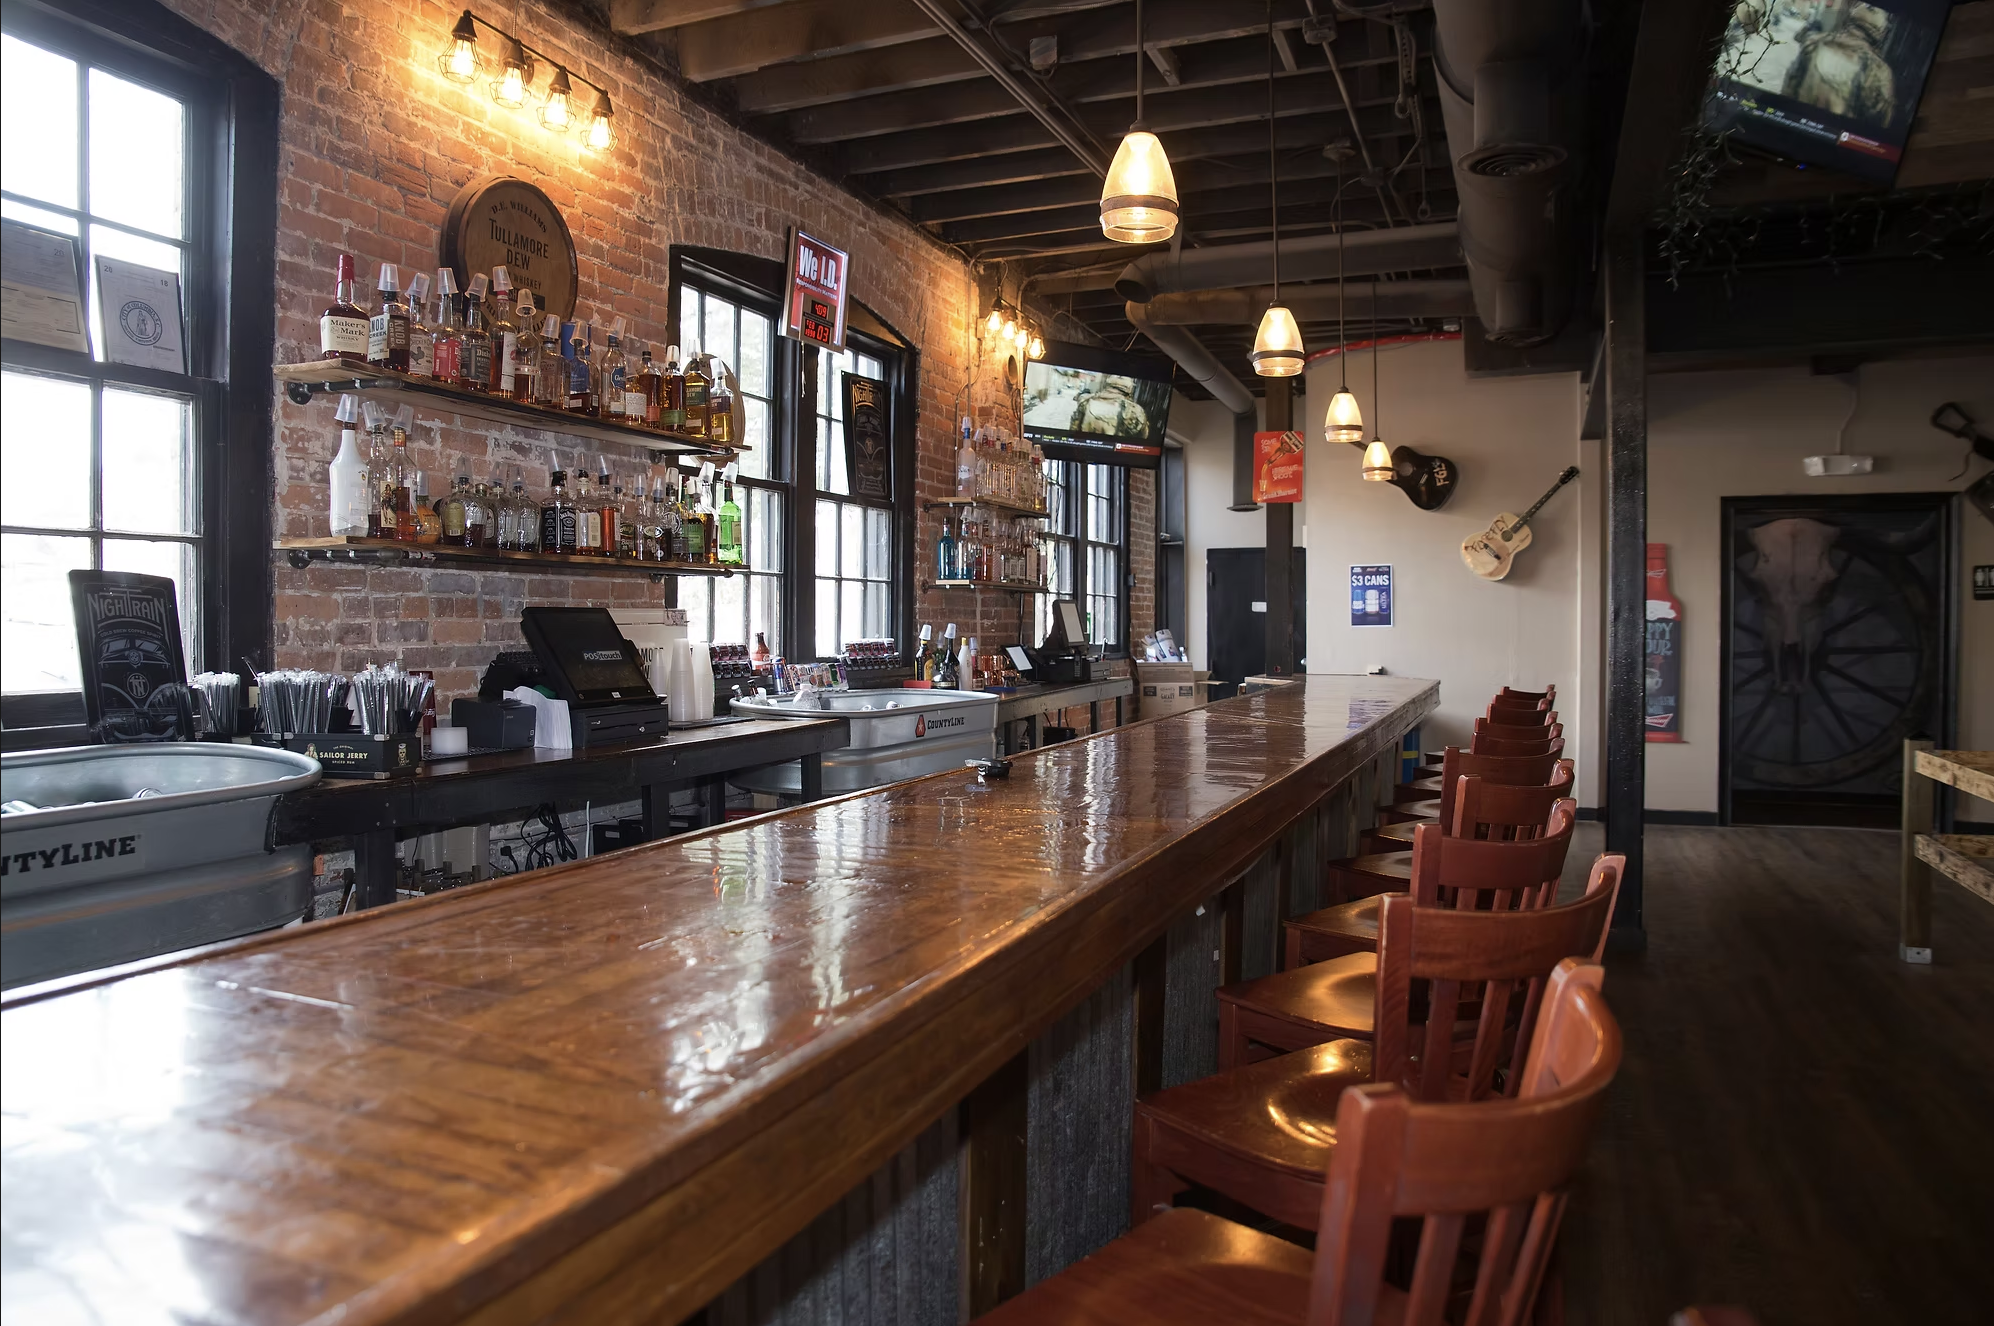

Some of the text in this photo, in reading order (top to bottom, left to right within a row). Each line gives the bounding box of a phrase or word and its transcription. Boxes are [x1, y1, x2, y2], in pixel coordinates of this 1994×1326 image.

[510, 200, 547, 233] WILLIAMS
[489, 218, 549, 259] TULLAMORE
[54, 248, 65, 256] 20
[104, 265, 169, 287] 20 18
[799, 245, 838, 291] We I.D.
[513, 275, 542, 291] WHISKEY
[330, 319, 366, 330] Maker's
[340, 328, 365, 337] Mark
[369, 317, 385, 333] NOB
[394, 319, 406, 345] KNOB
[369, 331, 387, 339] CREEK
[816, 325, 829, 343] 03
[1351, 575, 1390, 587] $3 CANS
[319, 751, 368, 760] SAILOR JERRY
